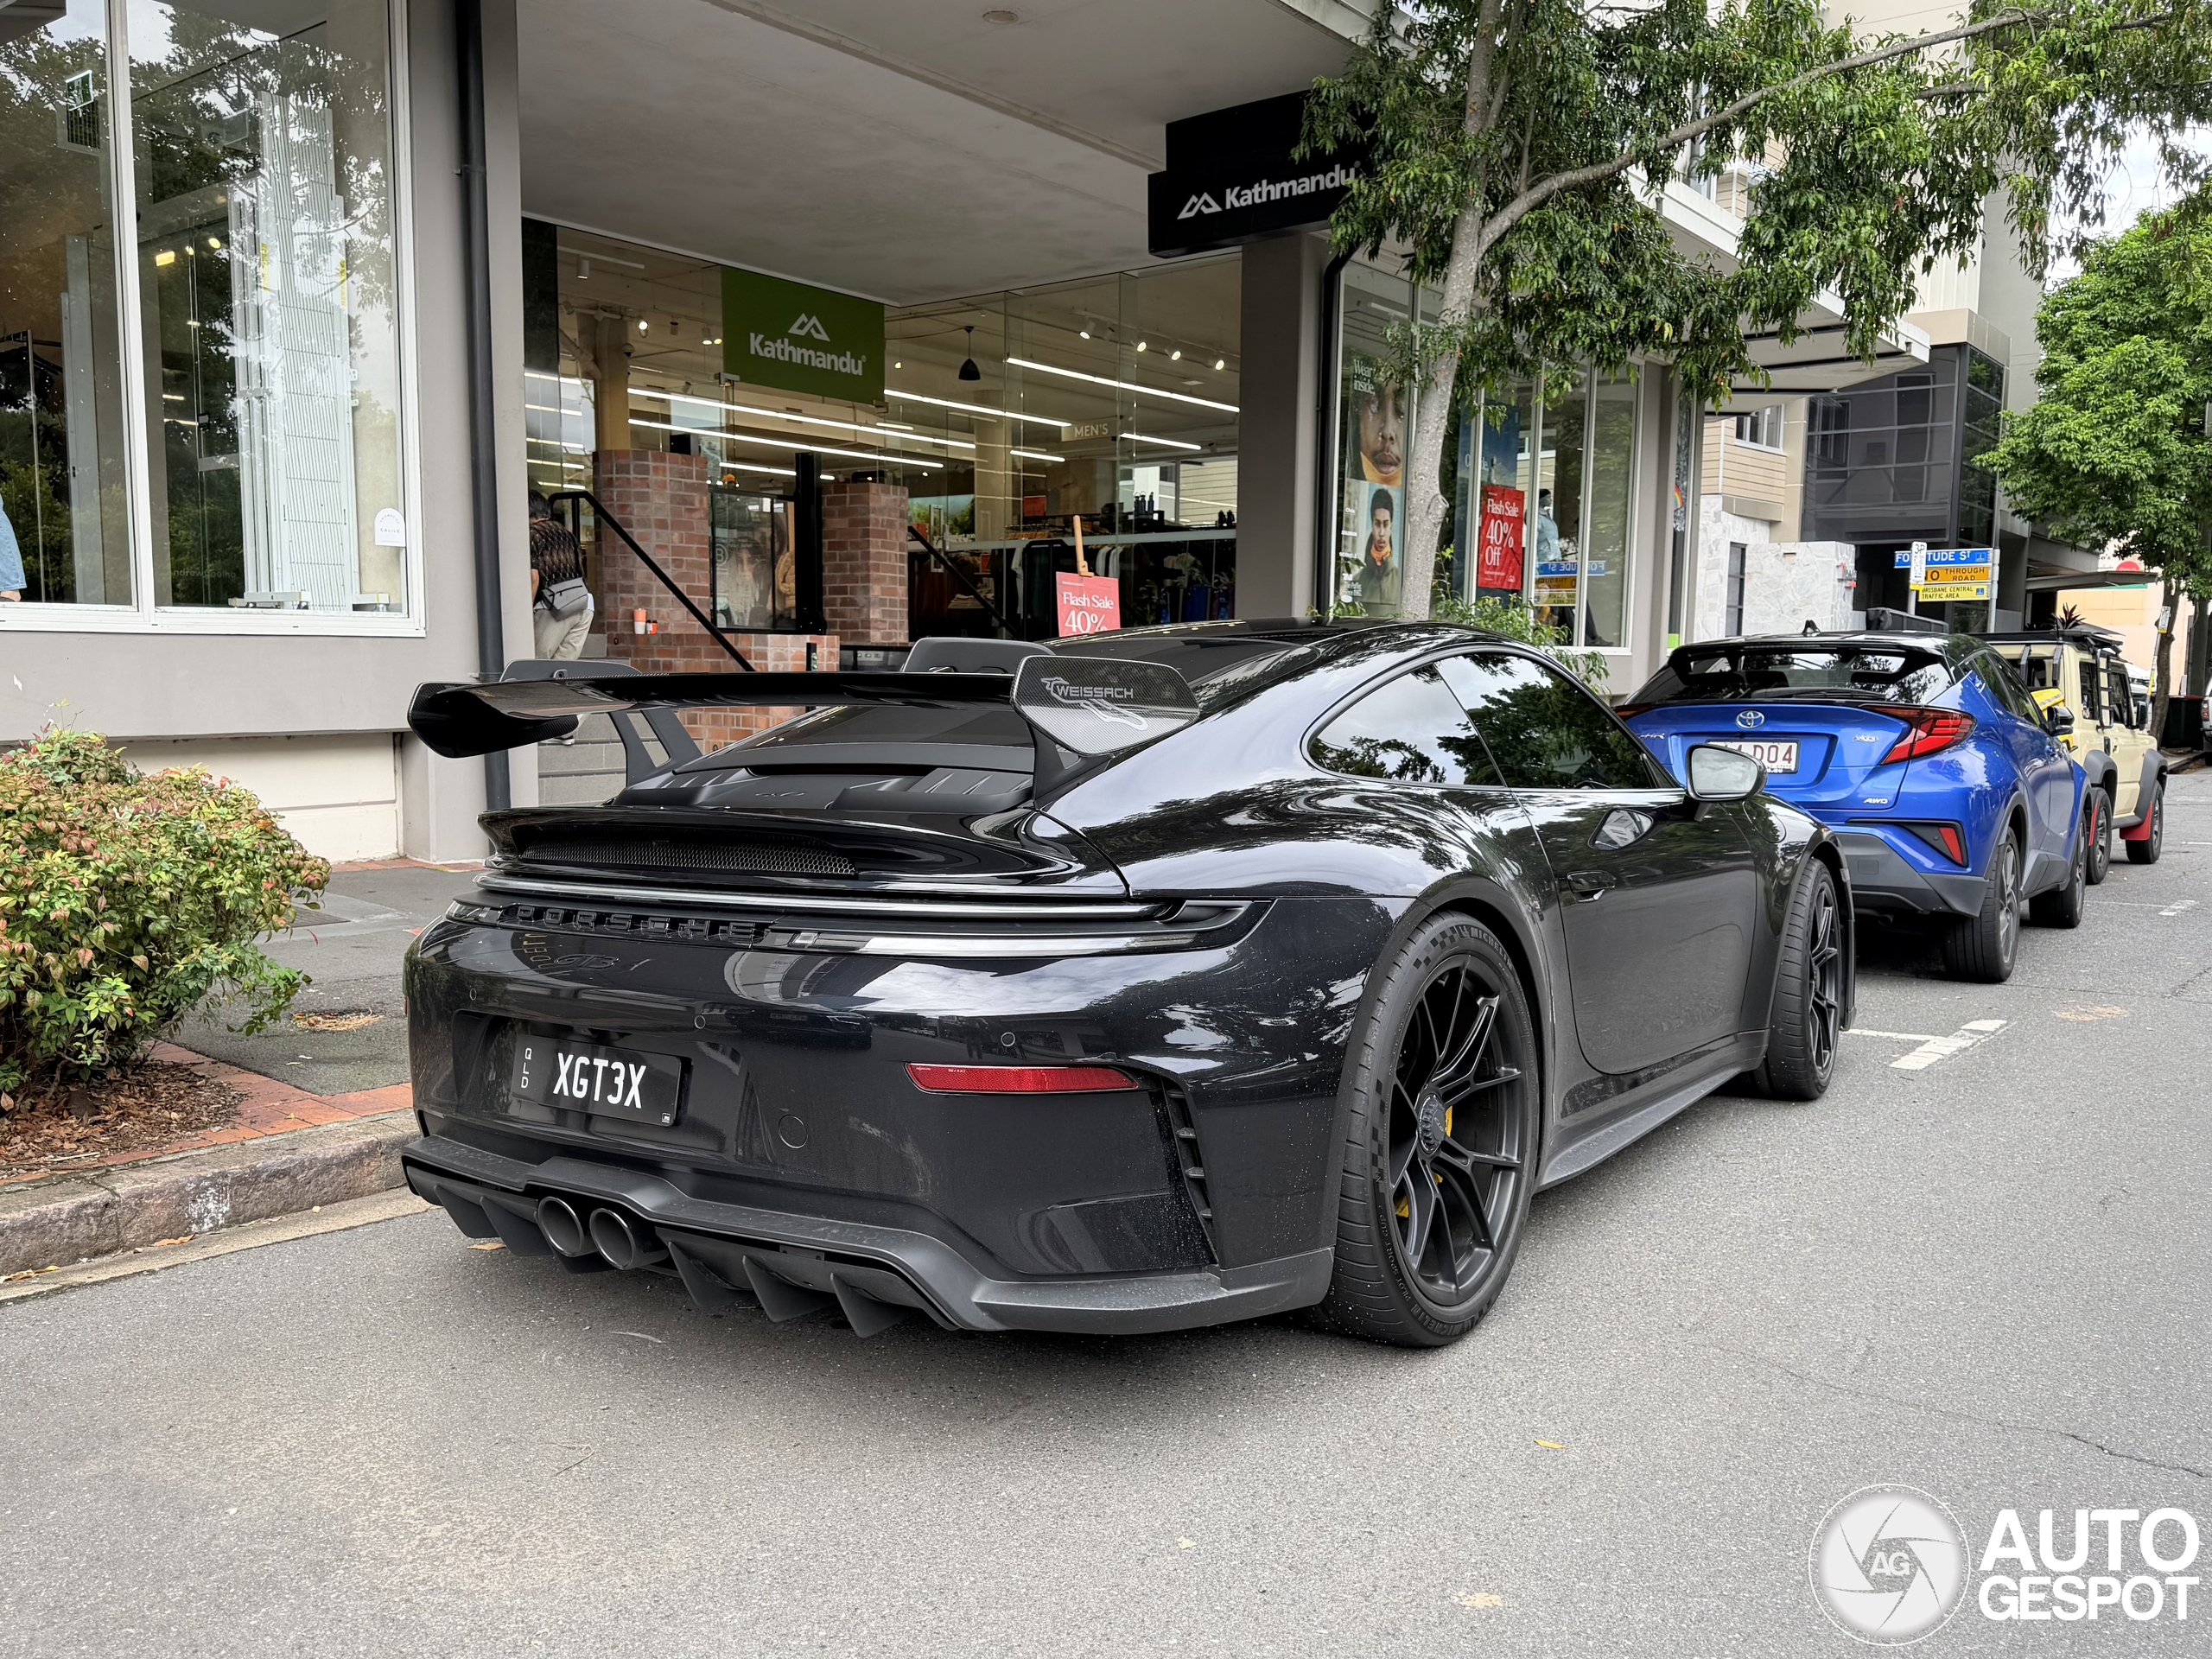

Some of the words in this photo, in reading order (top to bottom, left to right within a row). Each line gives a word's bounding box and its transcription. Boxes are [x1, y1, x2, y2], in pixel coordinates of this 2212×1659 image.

[1225, 164, 1355, 209] Kathmandu
[750, 332, 862, 376] Kathmandu
[1074, 423, 1109, 438] MEN'S
[1487, 499, 1504, 516] Flash
[1505, 501, 1519, 518] Sale
[1486, 518, 1514, 548] 40%
[1485, 545, 1502, 566] Off
[1896, 551, 1955, 563] FOTUDE
[1914, 543, 1925, 555] 3P
[1063, 591, 1090, 607] Flash
[1091, 594, 1114, 609] Sale
[1065, 610, 1108, 633] 40%
[1056, 685, 1134, 699] WEISSACH
[518, 906, 756, 940] PORSCHE
[1470, 926, 1514, 970] MICHELIN
[520, 1047, 532, 1089] QLD
[553, 1052, 646, 1109] XGT3X
[1384, 1242, 1400, 1274] SPORT
[1395, 1278, 1412, 1301] PILOT
